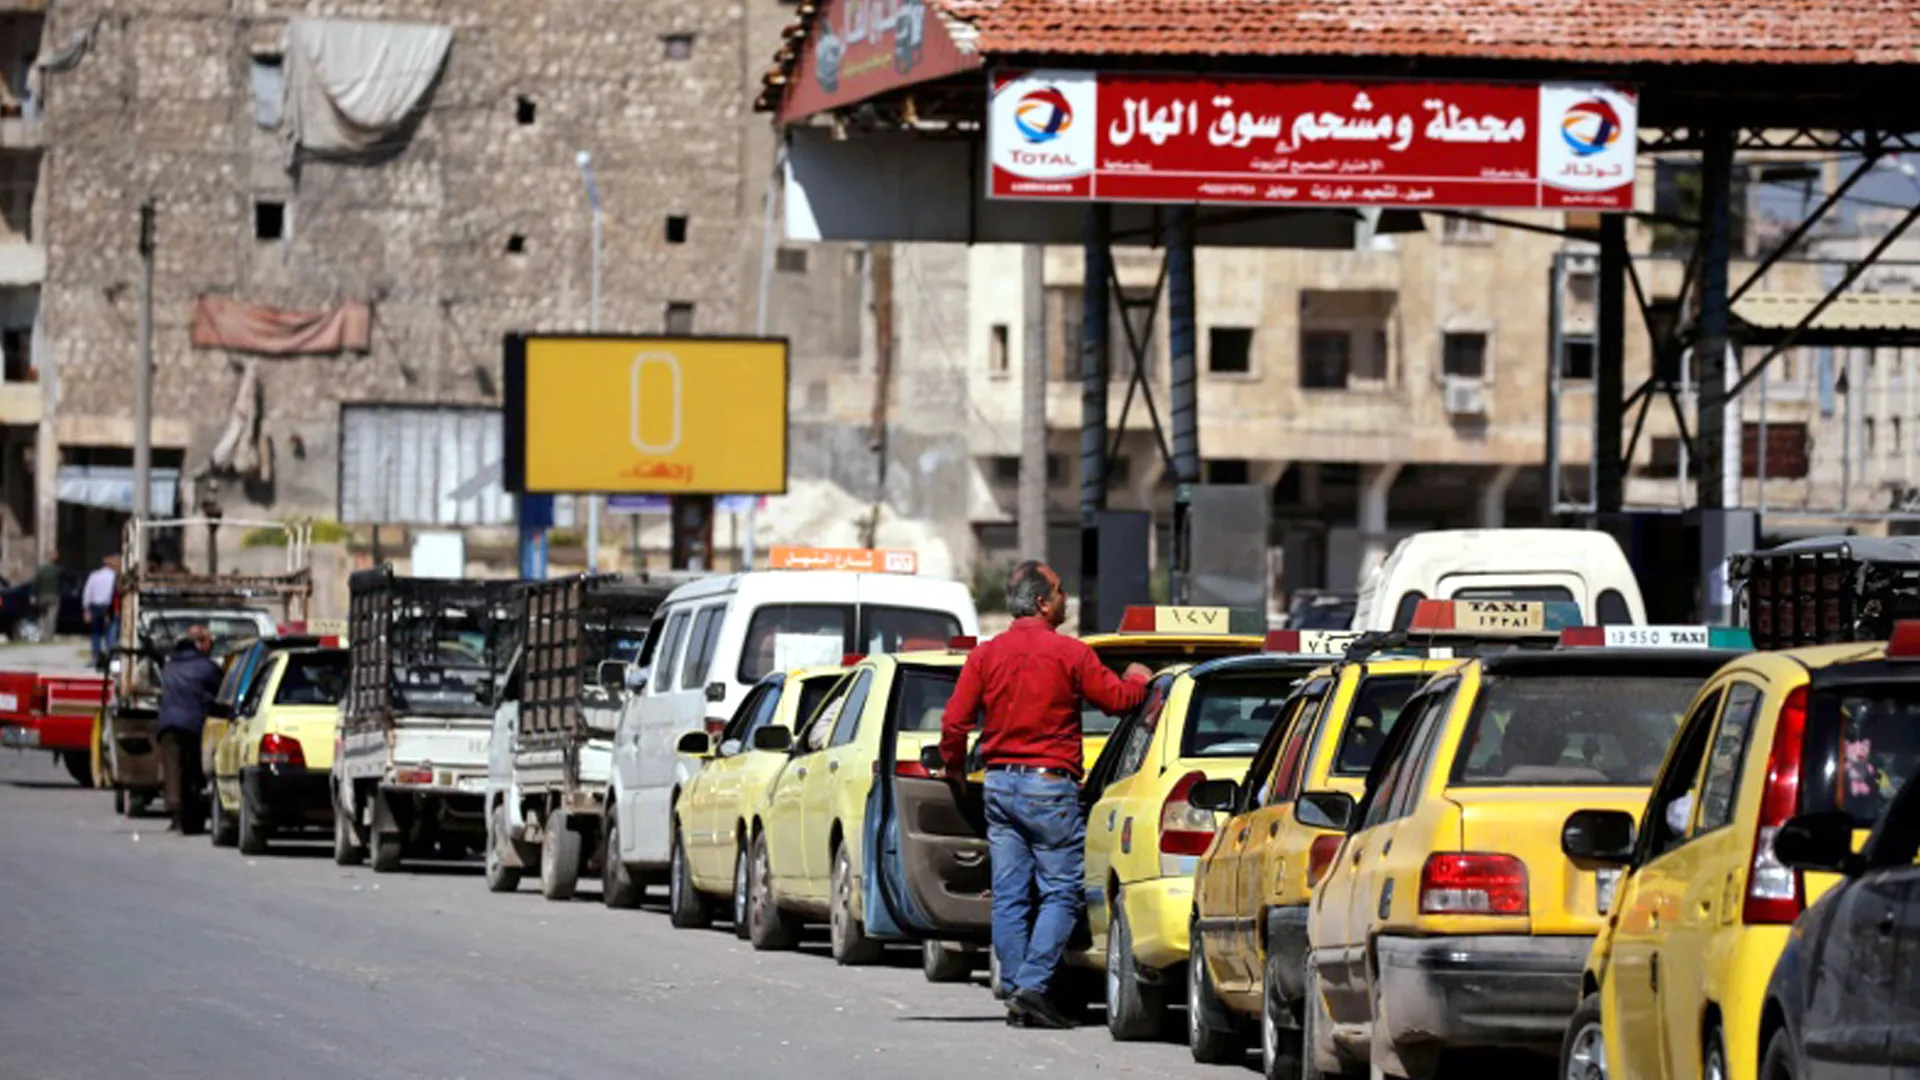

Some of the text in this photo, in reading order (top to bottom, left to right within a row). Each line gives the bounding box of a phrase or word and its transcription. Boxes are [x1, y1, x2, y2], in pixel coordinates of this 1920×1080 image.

[1108, 90, 1526, 152] محطة ومشحم سوق الهال
[1468, 601, 1528, 612] TAXI
[1670, 631, 1706, 644] TAXI
